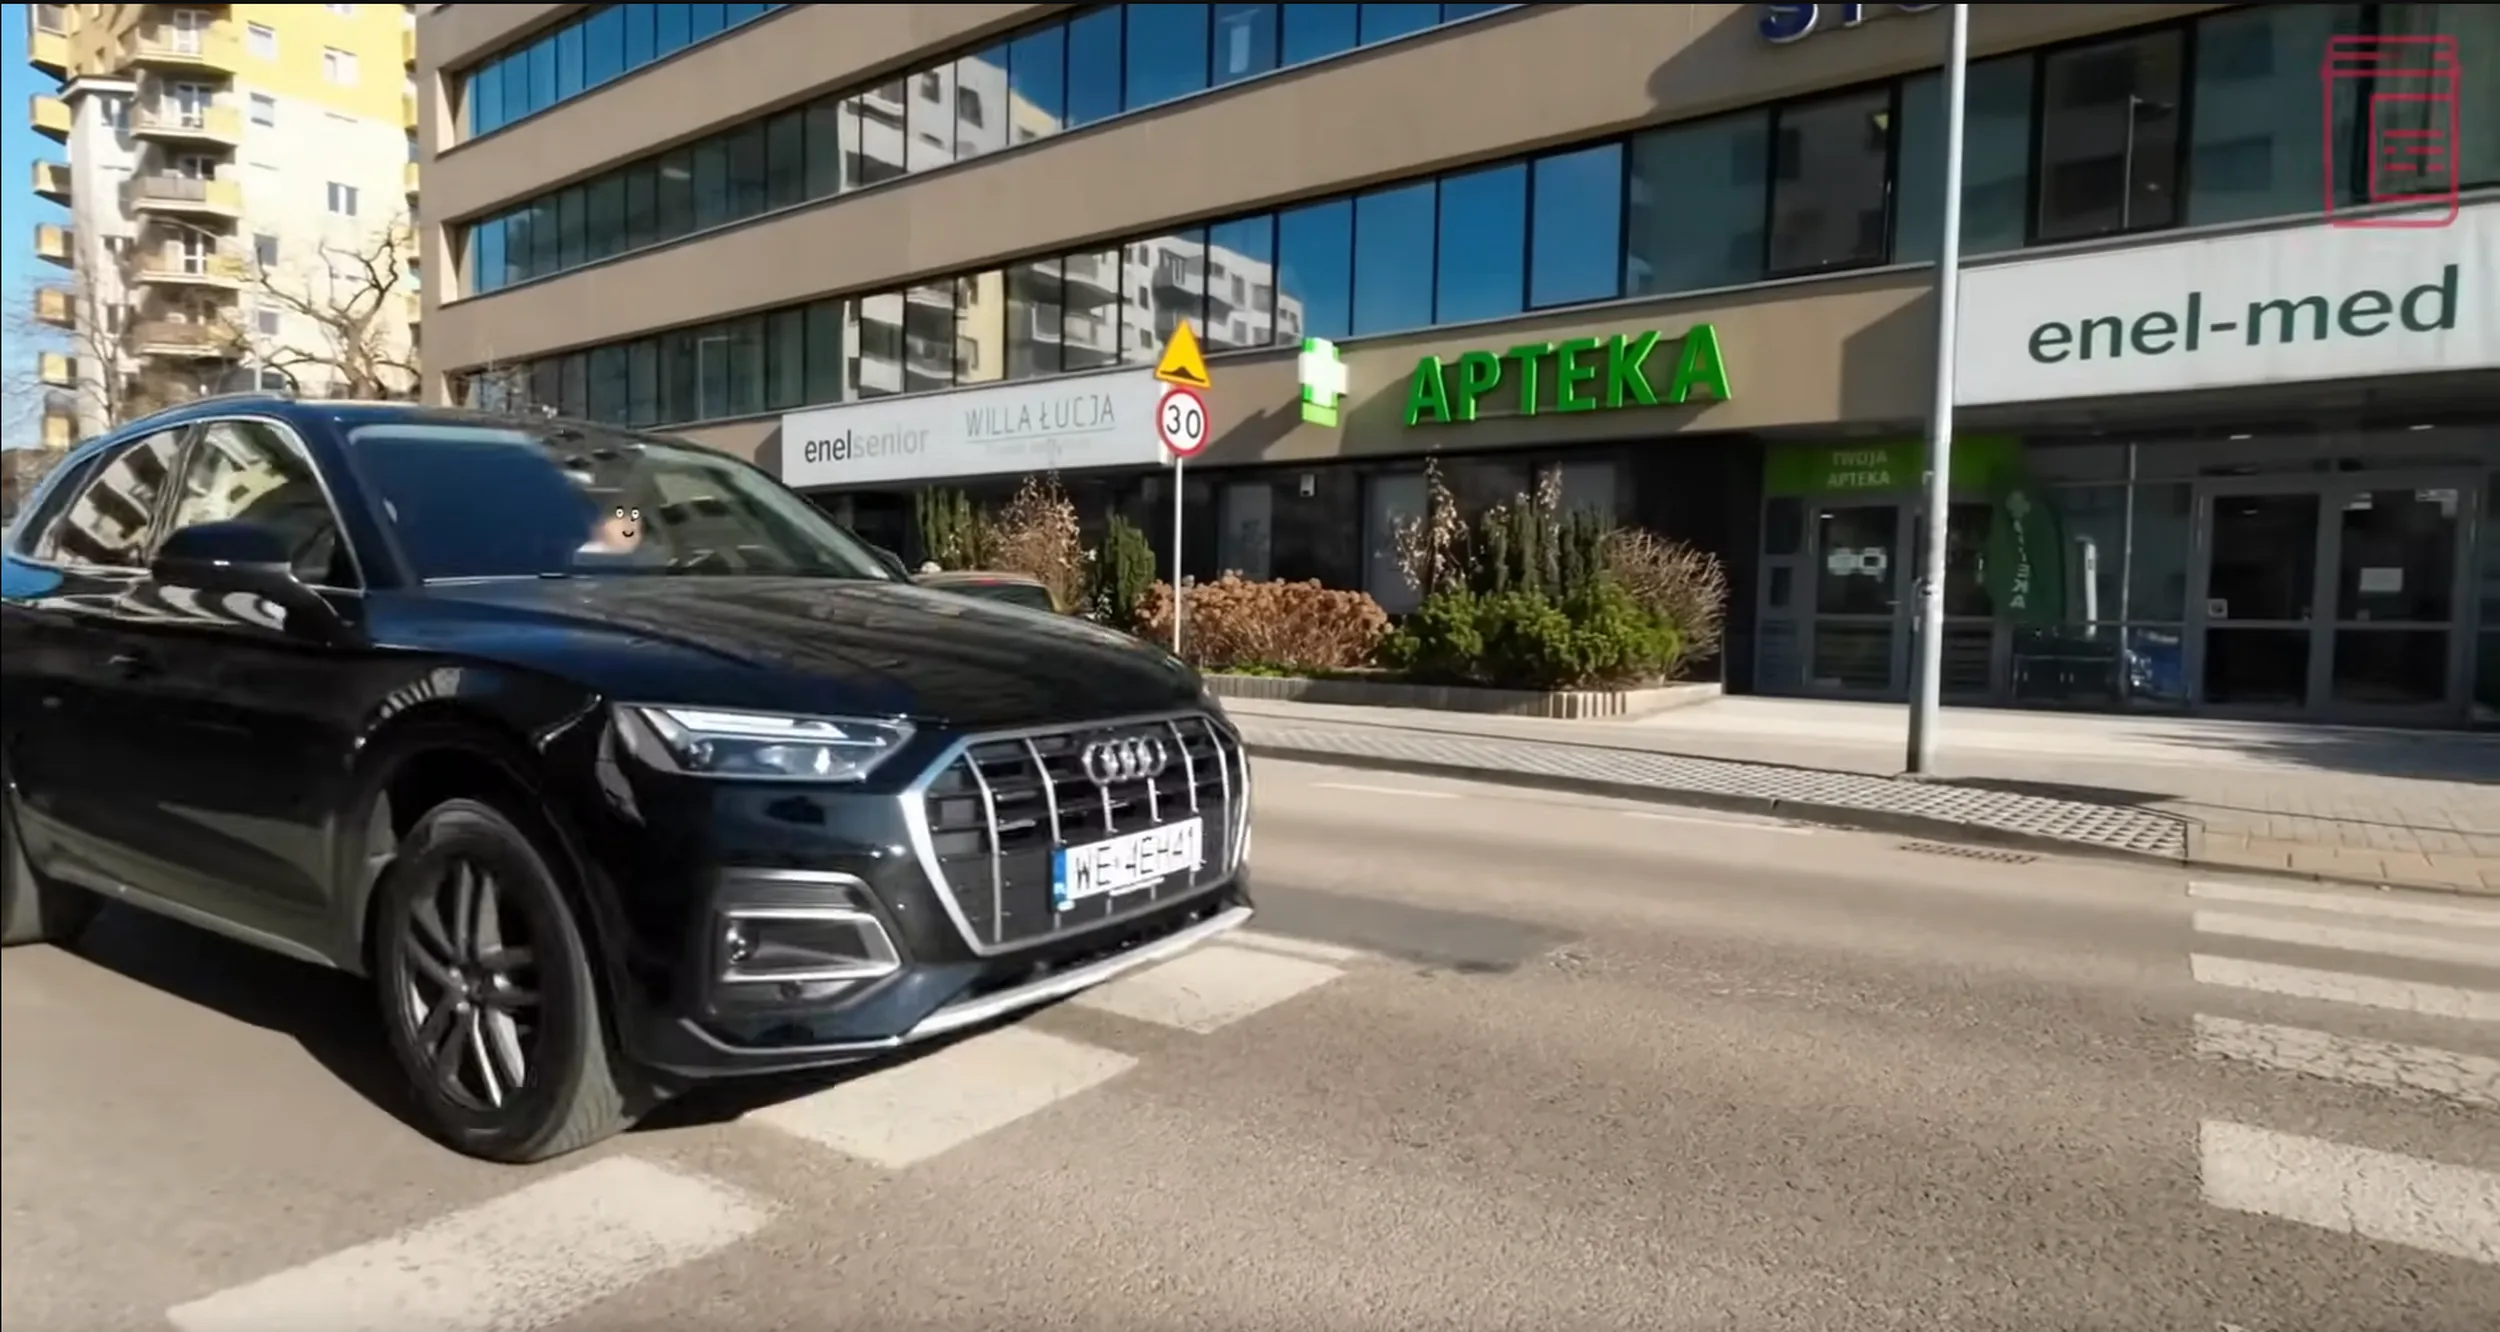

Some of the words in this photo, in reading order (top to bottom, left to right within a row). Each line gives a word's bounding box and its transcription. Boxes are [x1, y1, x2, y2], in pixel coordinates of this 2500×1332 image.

[2027, 264, 2458, 364] enel-med
[1404, 324, 1732, 426] APTEKA
[965, 407, 1032, 438] WILLA
[1038, 394, 1116, 430] ŁUCJA
[1166, 404, 1201, 439] 30
[804, 429, 929, 463] enelsenior
[1833, 450, 1888, 467] TWOJA
[1827, 470, 1890, 488] APTEKA
[1075, 846, 1111, 890] WE
